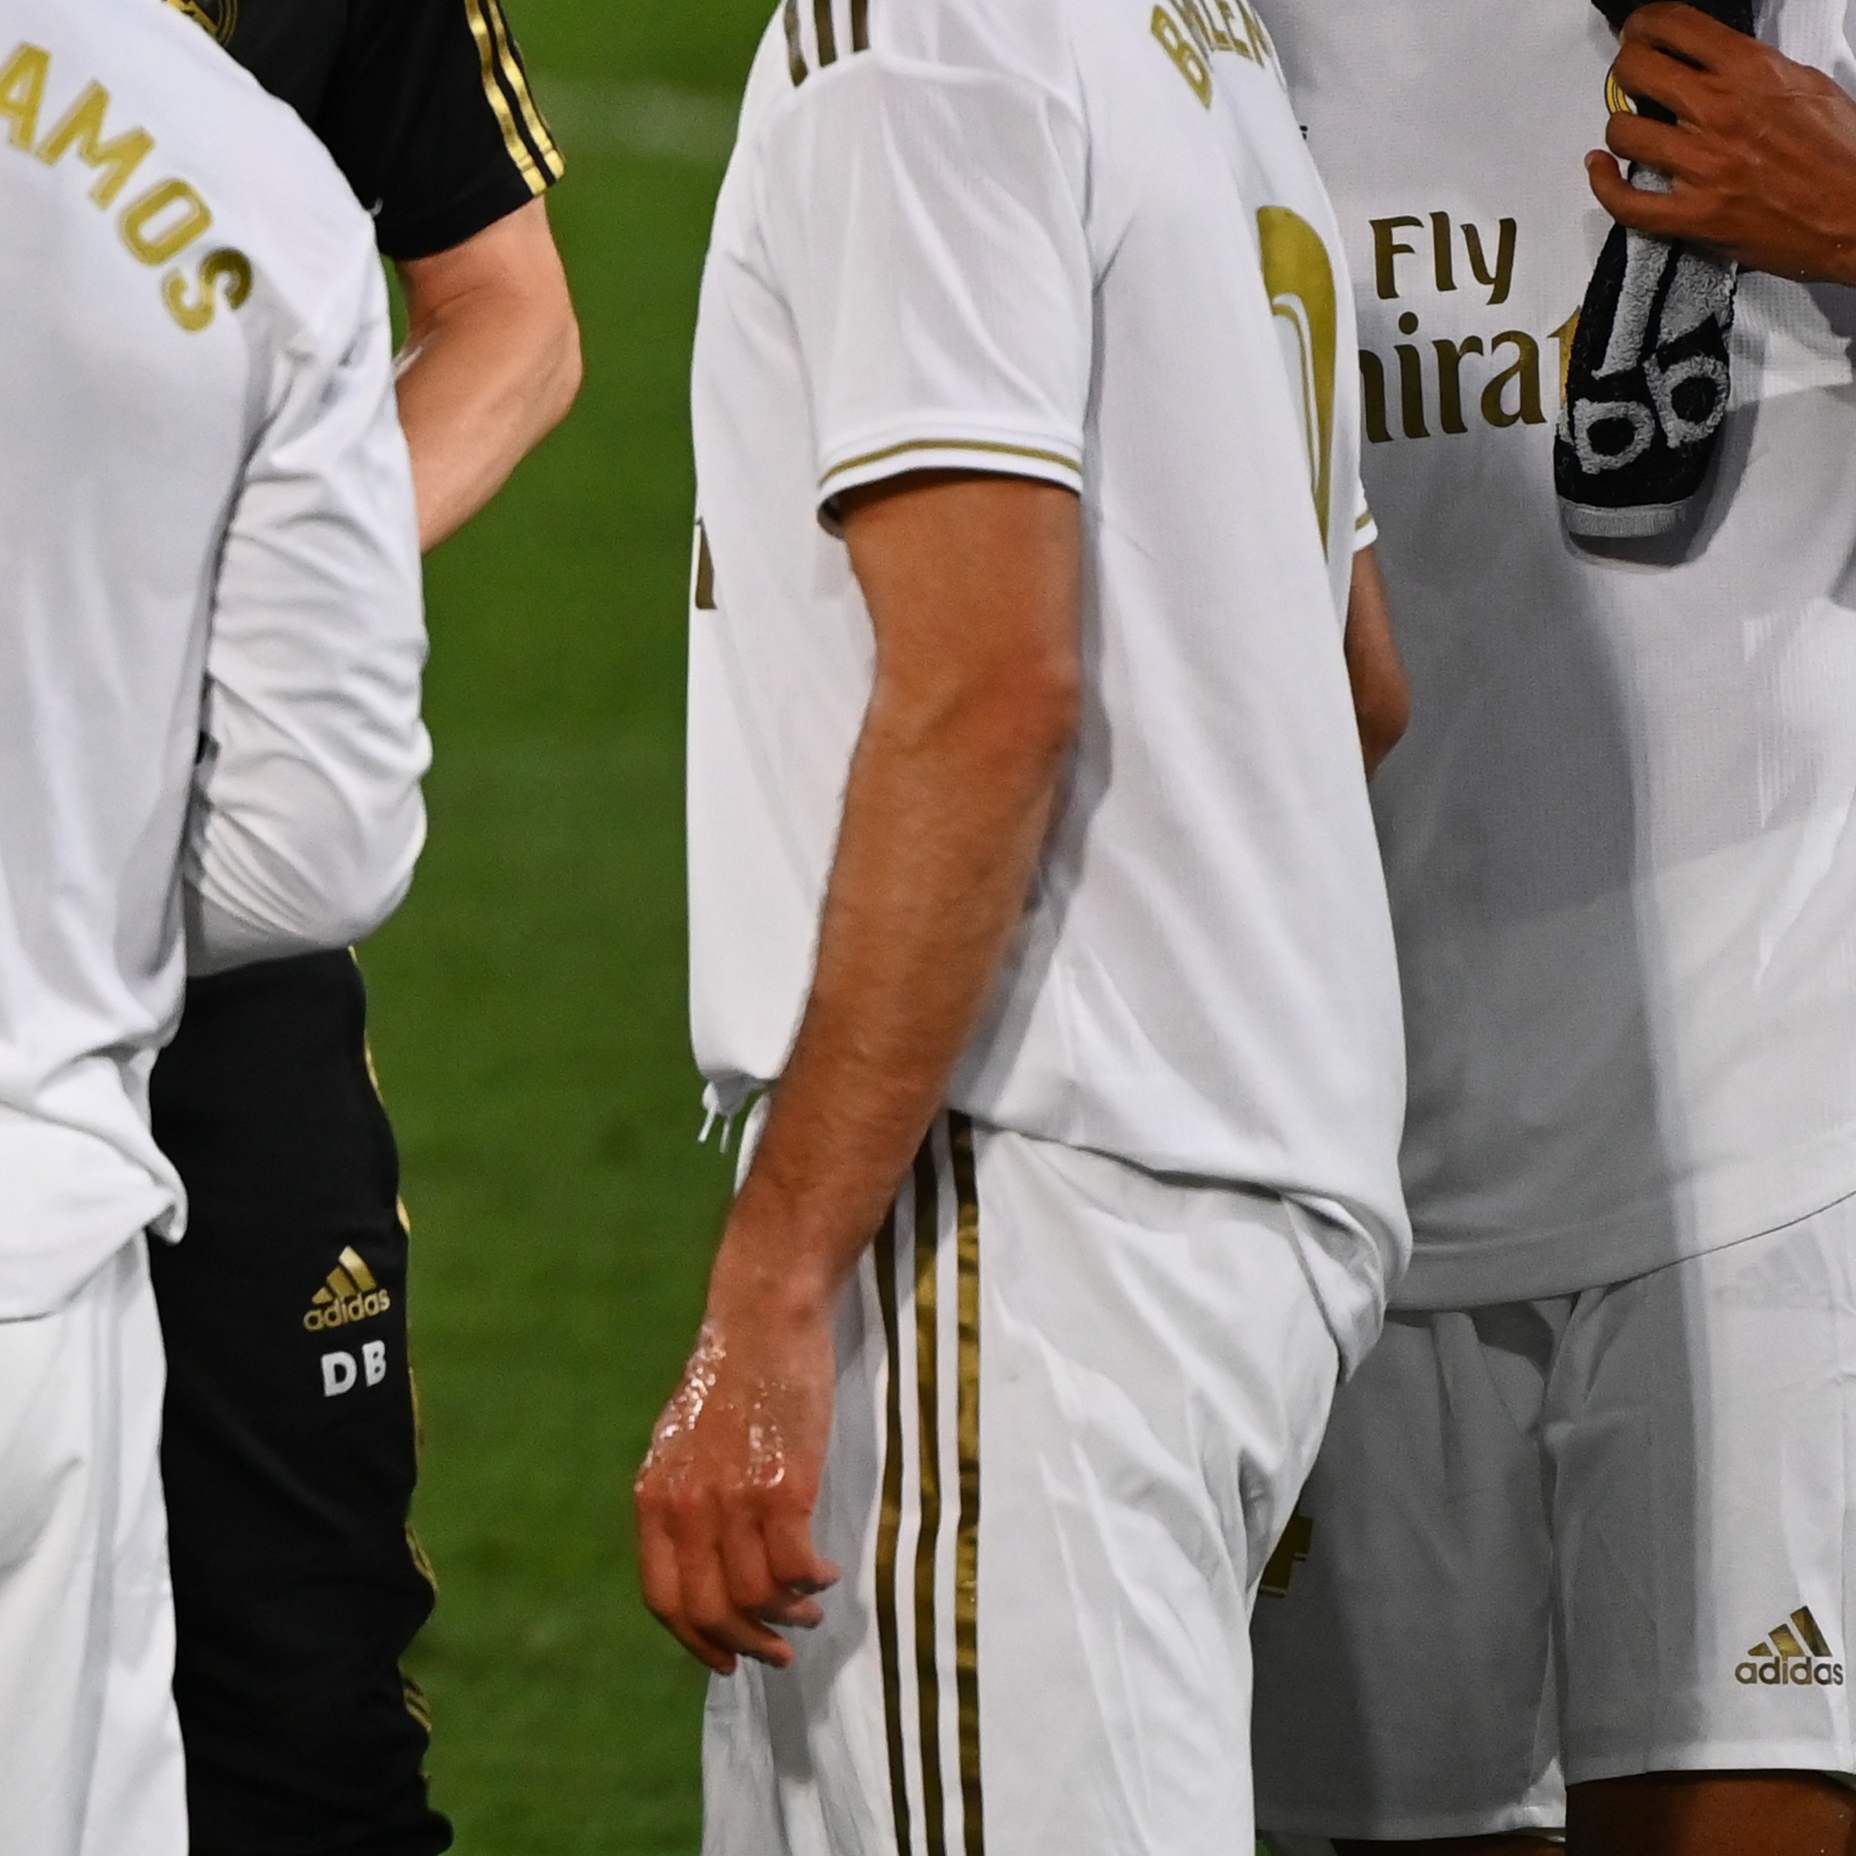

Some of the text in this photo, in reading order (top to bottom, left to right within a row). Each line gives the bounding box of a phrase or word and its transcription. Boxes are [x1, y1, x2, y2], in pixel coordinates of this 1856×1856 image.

[1368, 210, 1518, 306] Fly
[303, 1286, 391, 1333] adidas
[320, 1339, 387, 1397] DB
[1734, 1655, 1845, 1686] adidas
